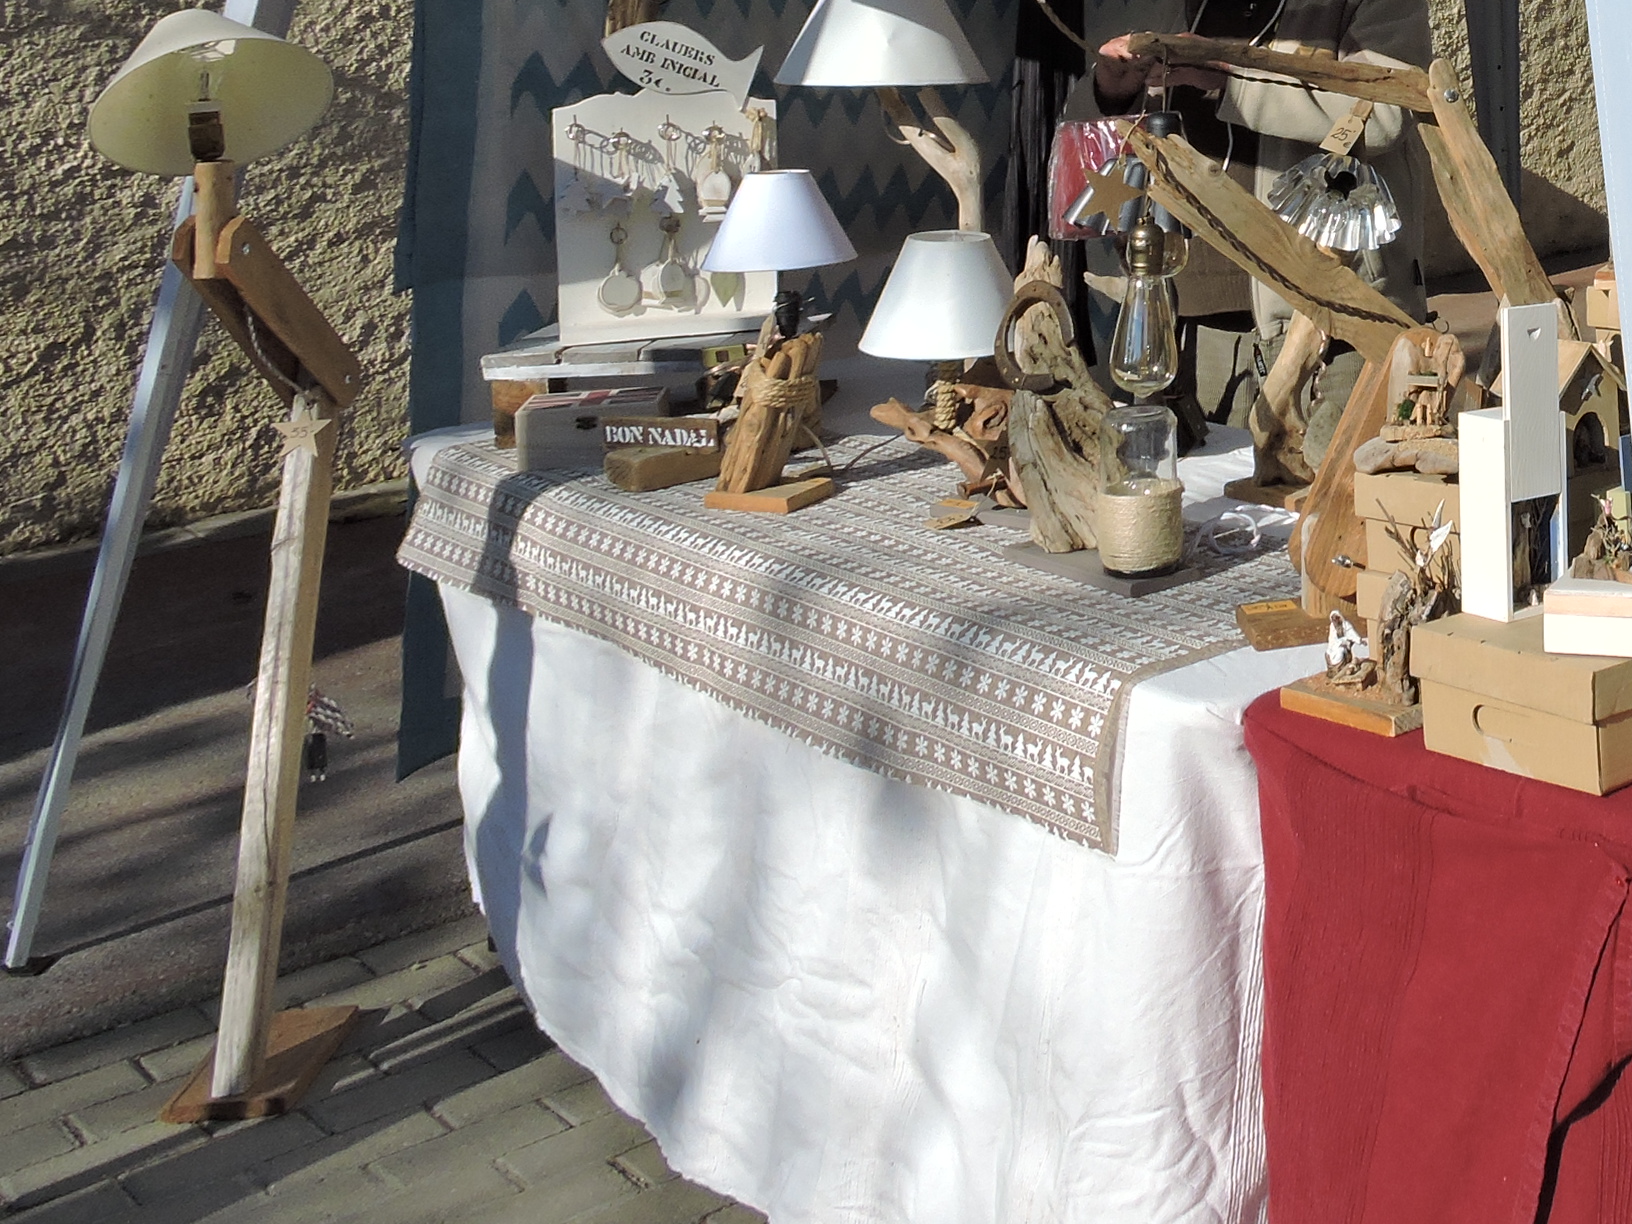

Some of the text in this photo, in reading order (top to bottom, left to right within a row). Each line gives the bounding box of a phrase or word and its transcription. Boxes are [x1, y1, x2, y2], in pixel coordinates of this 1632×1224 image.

[620, 43, 721, 88] AMB INICIAL
[639, 30, 716, 66] CLAUERS
[605, 425, 715, 448] BON NADAL
